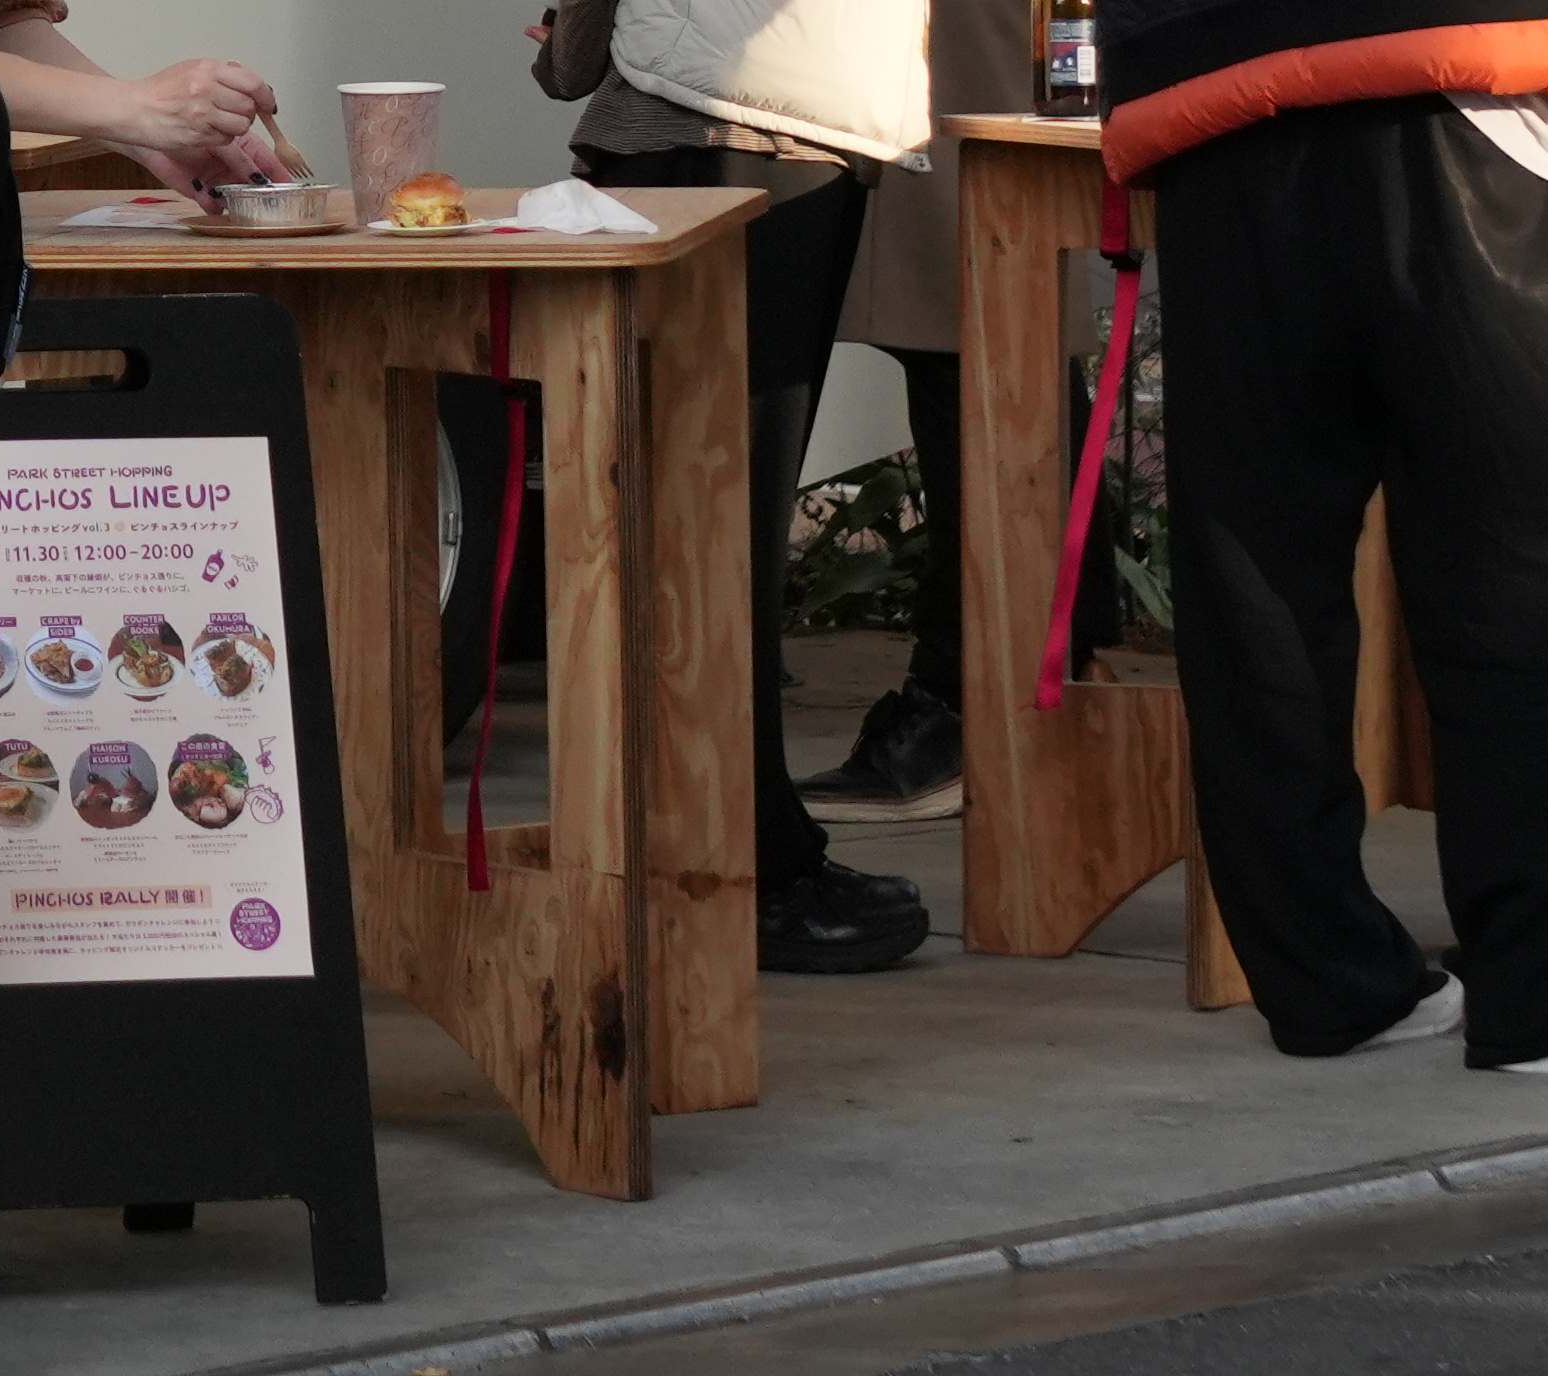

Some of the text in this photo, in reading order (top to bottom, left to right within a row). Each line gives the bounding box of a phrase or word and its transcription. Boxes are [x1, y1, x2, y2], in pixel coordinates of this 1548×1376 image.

[7, 465, 173, 480] PARK STREET HOPPING
[109, 484, 231, 512] LINEUP
[13, 545, 60, 562] 11.30
[124, 615, 164, 625] COUNTER
[211, 613, 244, 623] PARLOR
[91, 743, 127, 754] MAISON
[15, 891, 94, 909] PINCHOS
[99, 889, 161, 905] RALLY
